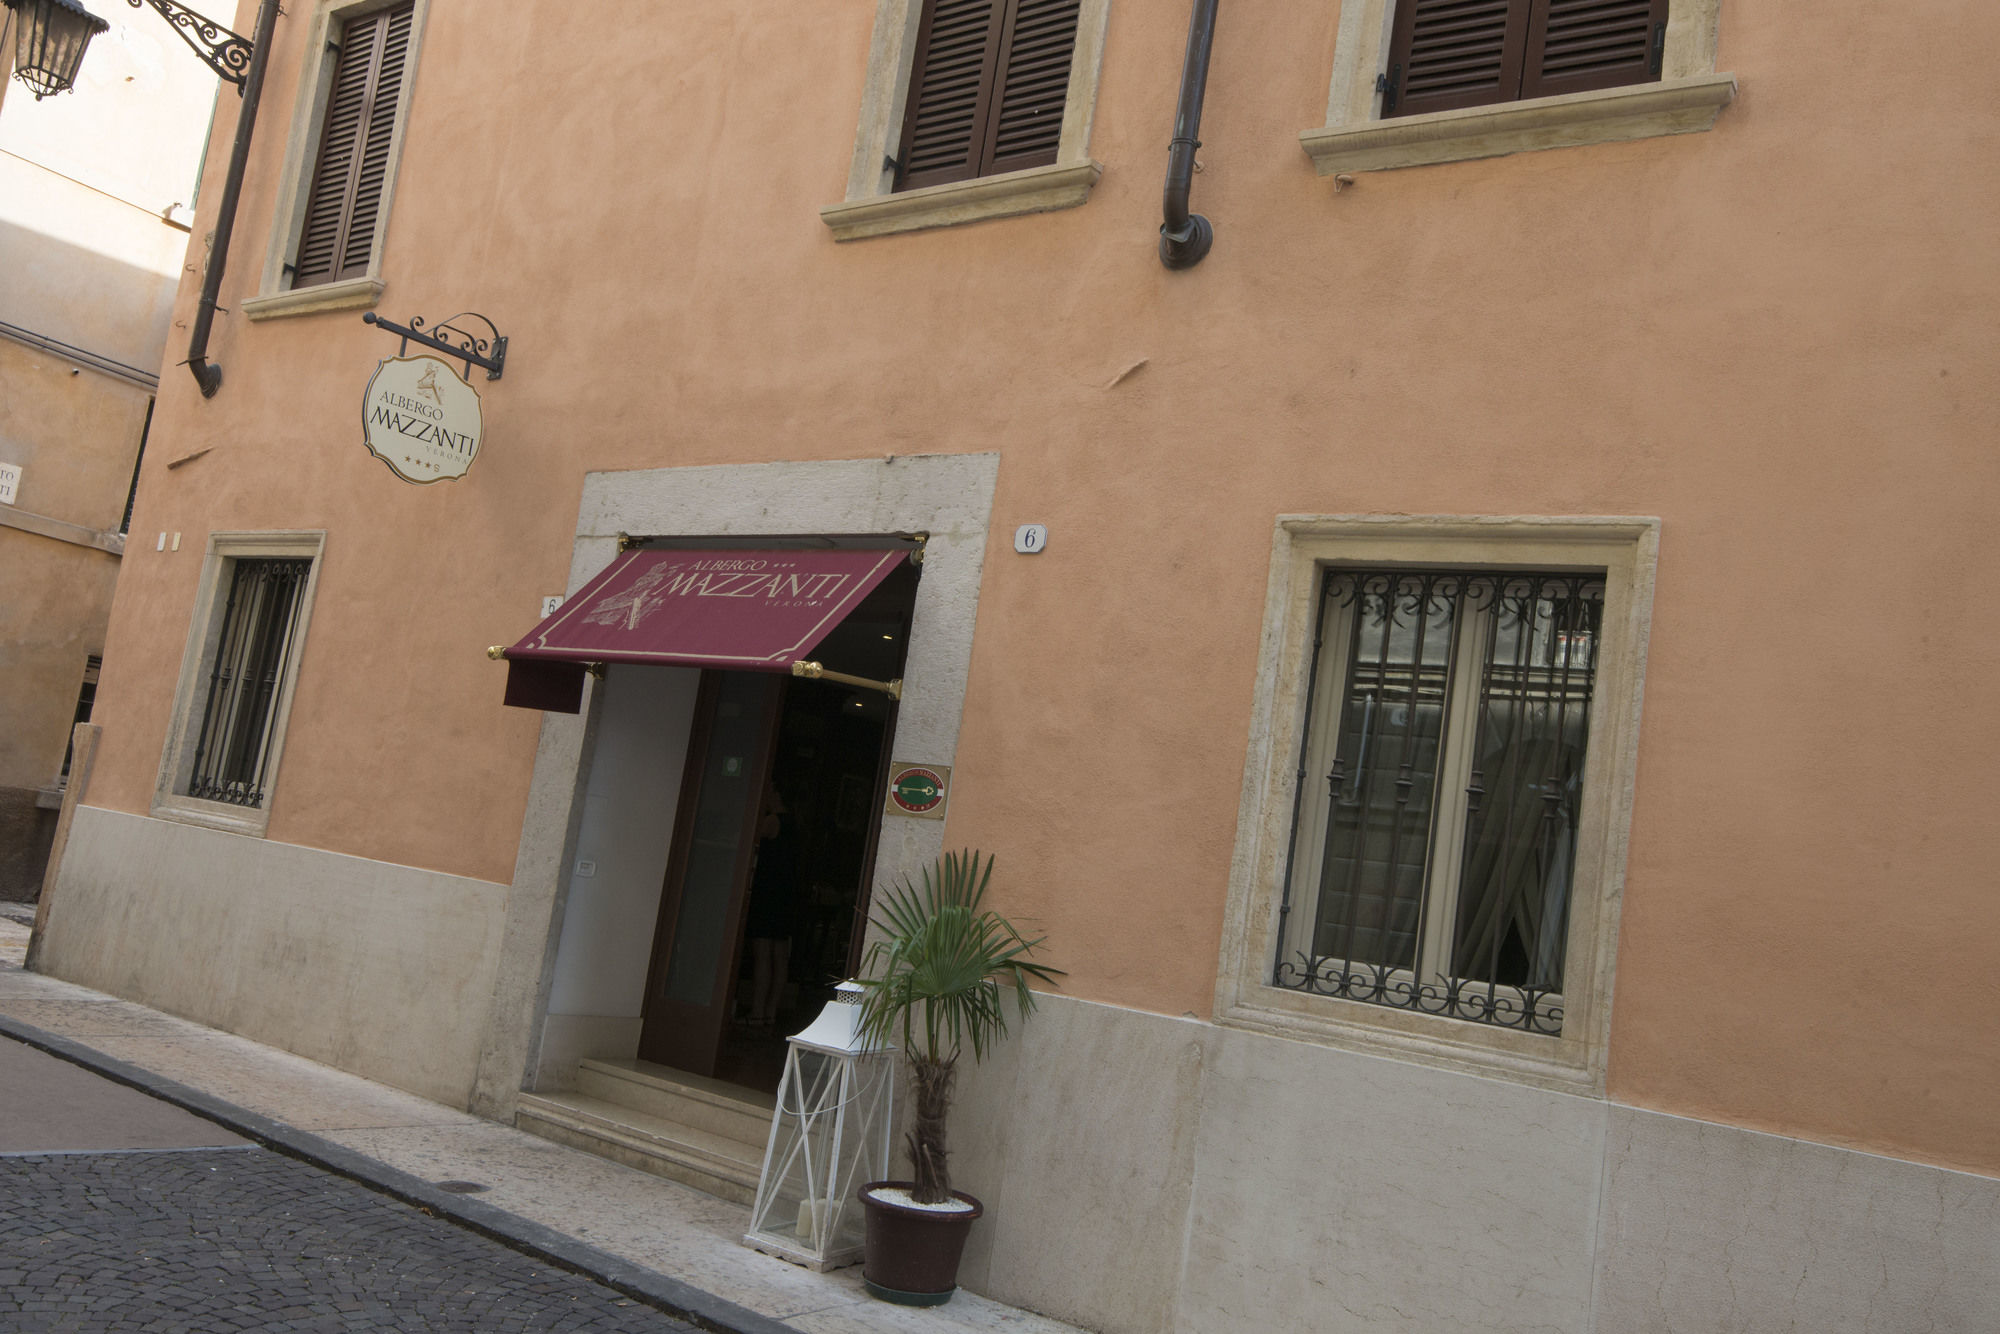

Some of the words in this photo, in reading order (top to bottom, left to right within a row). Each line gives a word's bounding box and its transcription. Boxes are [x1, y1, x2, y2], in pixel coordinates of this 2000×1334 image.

[379, 391, 443, 421] ALBERGO
[370, 406, 474, 456] MAZZANTI
[426, 445, 468, 465] VERONA
[1025, 528, 1036, 548] 6
[689, 559, 767, 571] ALBERGO
[651, 573, 850, 598] MAZZANTI
[549, 598, 556, 615] 6
